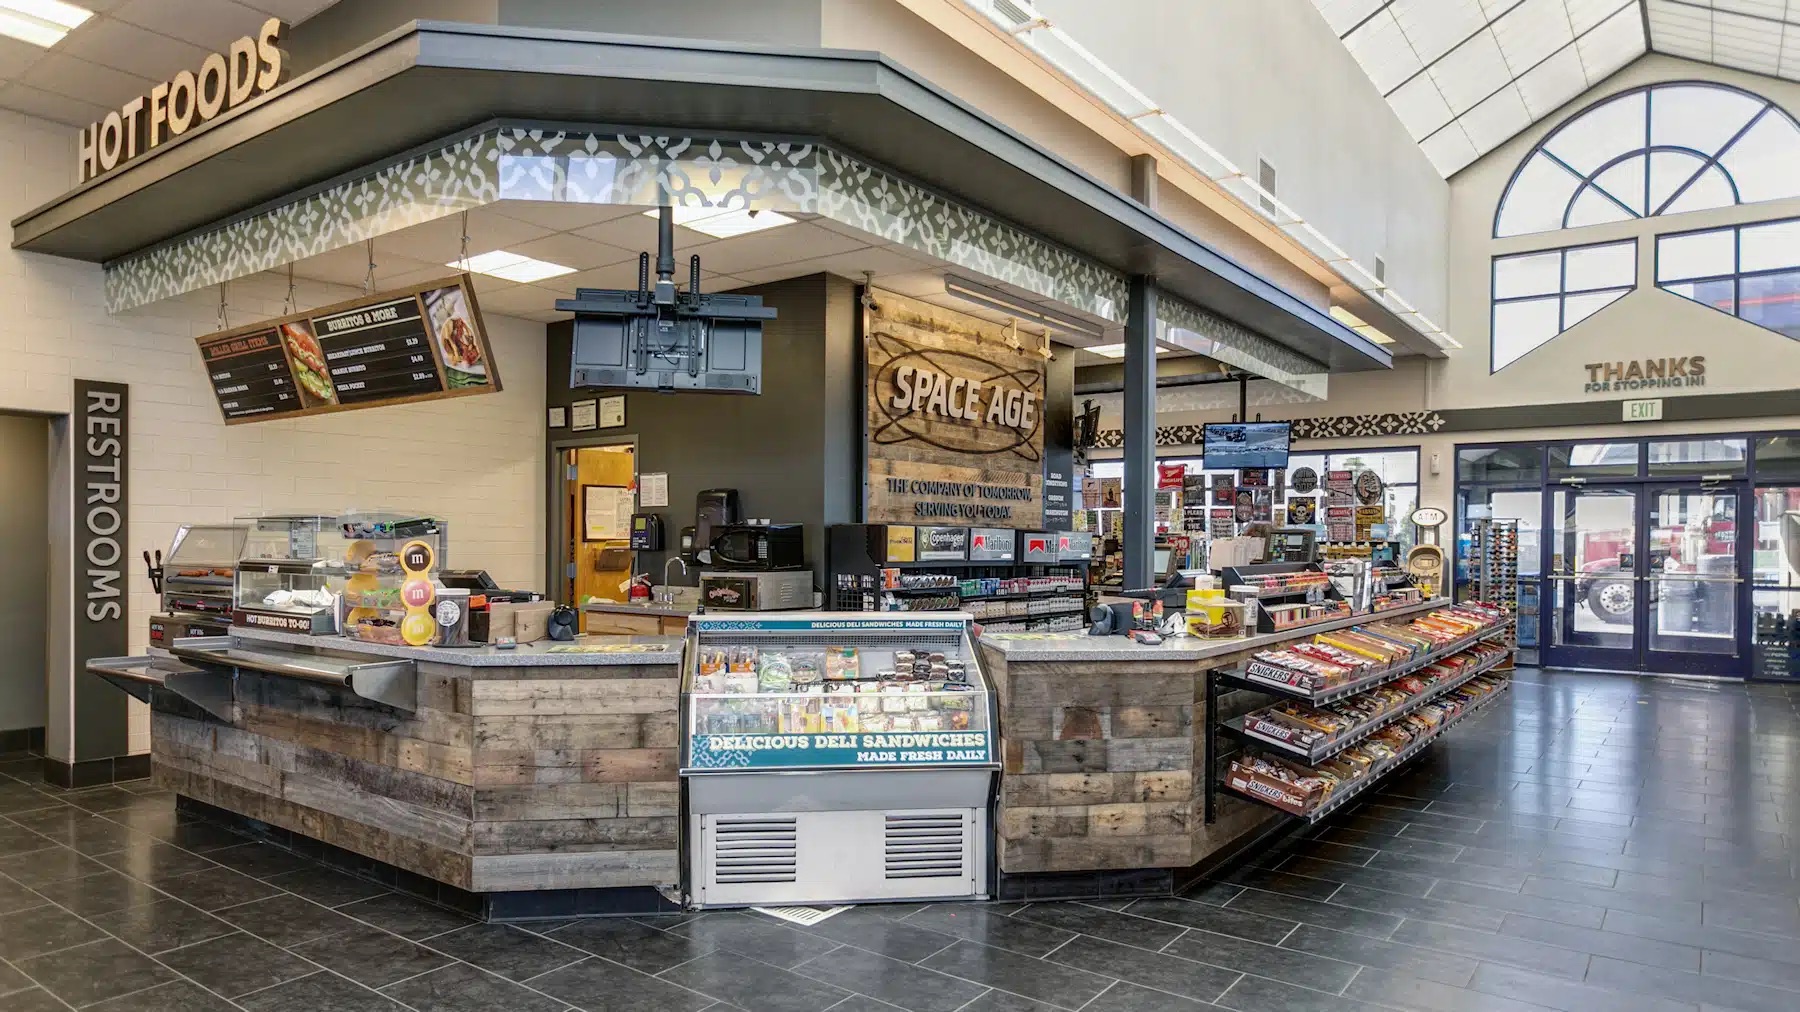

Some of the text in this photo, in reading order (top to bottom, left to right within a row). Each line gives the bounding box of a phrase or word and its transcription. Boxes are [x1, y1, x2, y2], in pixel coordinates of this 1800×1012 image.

[78, 17, 285, 184] HOT FOODS
[327, 307, 398, 332] BURRITOS & MORE
[1585, 356, 1705, 382] THANKS
[1584, 376, 1705, 393] FOR STOPPING IN!
[893, 365, 1036, 430] SPACE AGE
[1631, 402, 1655, 418] EXIT
[887, 477, 1033, 501] THE COMPANY OF TOMORROW,
[86, 390, 122, 622] RESTROOMS
[915, 501, 1012, 519] SERVING YOU TODAY.
[1418, 513, 1438, 521] ATM
[930, 530, 965, 547] Copenhagen
[984, 535, 1012, 551] Marlboro
[411, 553, 424, 564] m
[412, 587, 424, 600] m
[246, 613, 310, 630] HOT BURRITOS TO-GO!
[412, 623, 424, 634] m
[1249, 663, 1291, 683] SNICKERS
[1256, 722, 1291, 739] SNICKERS
[709, 733, 986, 752] DELICIOUS DELI SANDWICHES
[857, 750, 986, 762] MADE FRESH DAILY
[1248, 781, 1283, 799] SNICKERS
